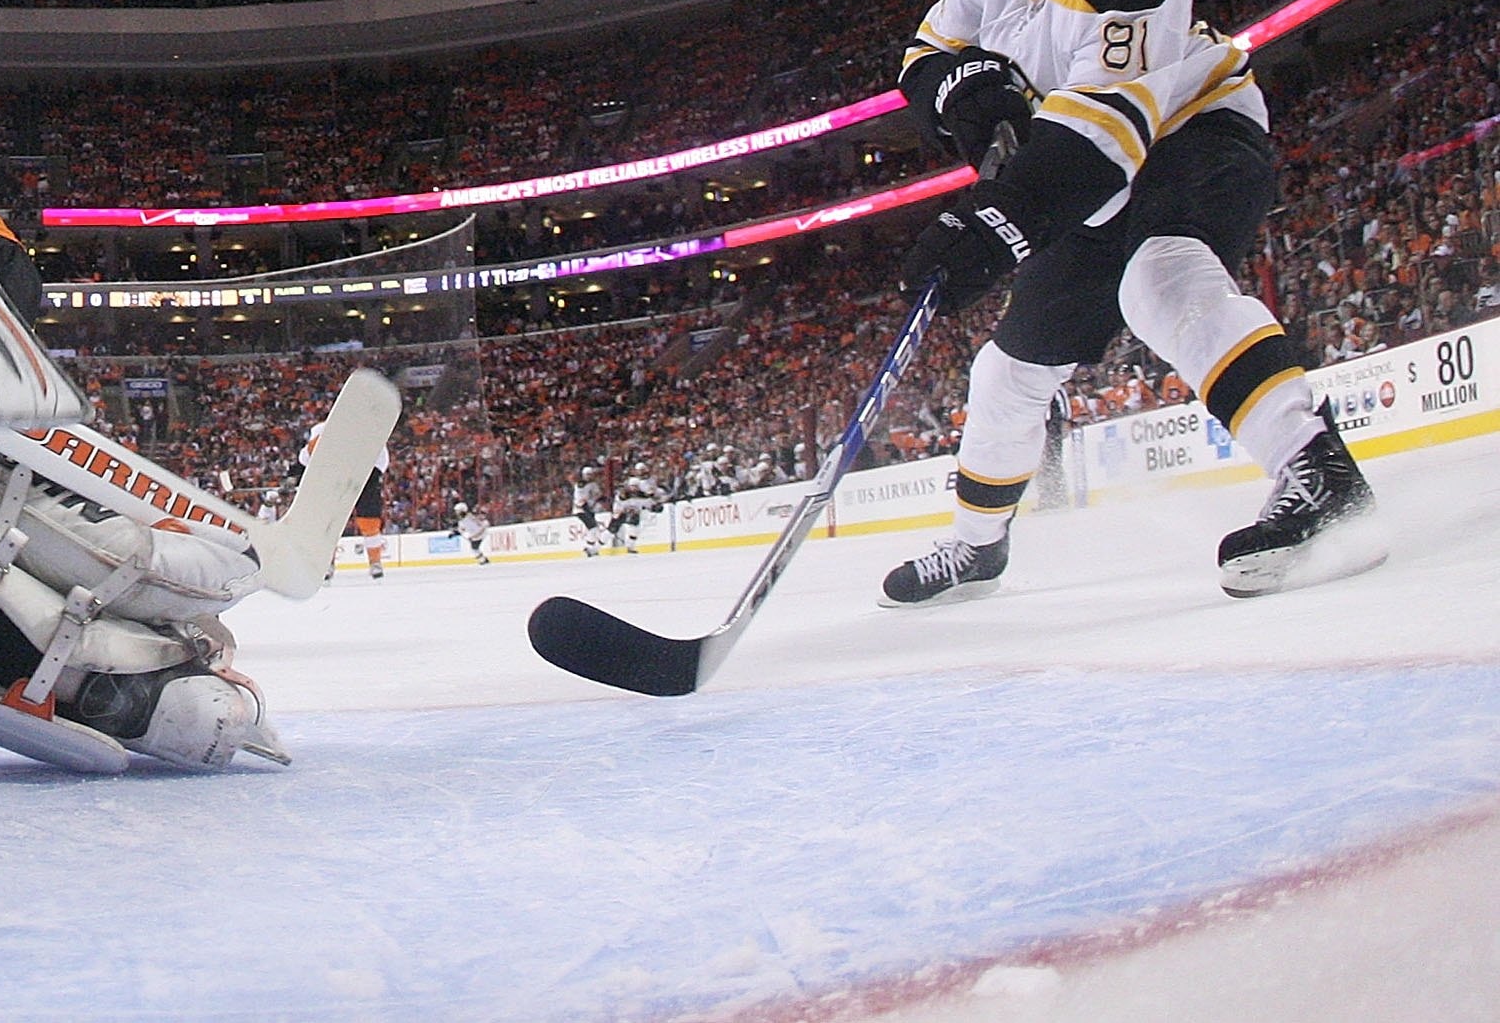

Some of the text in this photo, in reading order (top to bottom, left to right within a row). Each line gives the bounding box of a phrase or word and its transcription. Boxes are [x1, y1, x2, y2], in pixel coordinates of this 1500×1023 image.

[1102, 19, 1148, 70] 81
[440, 114, 833, 207] AMERICA'S MOST RELIABLE WIRELESS NETWORK
[1407, 362, 1418, 384] $
[1437, 335, 1474, 386] 80
[1421, 382, 1479, 413] MILLION
[1131, 413, 1199, 444] Choose
[879, 477, 937, 501] AIRWAYS
[695, 503, 741, 527] TOYOTA
